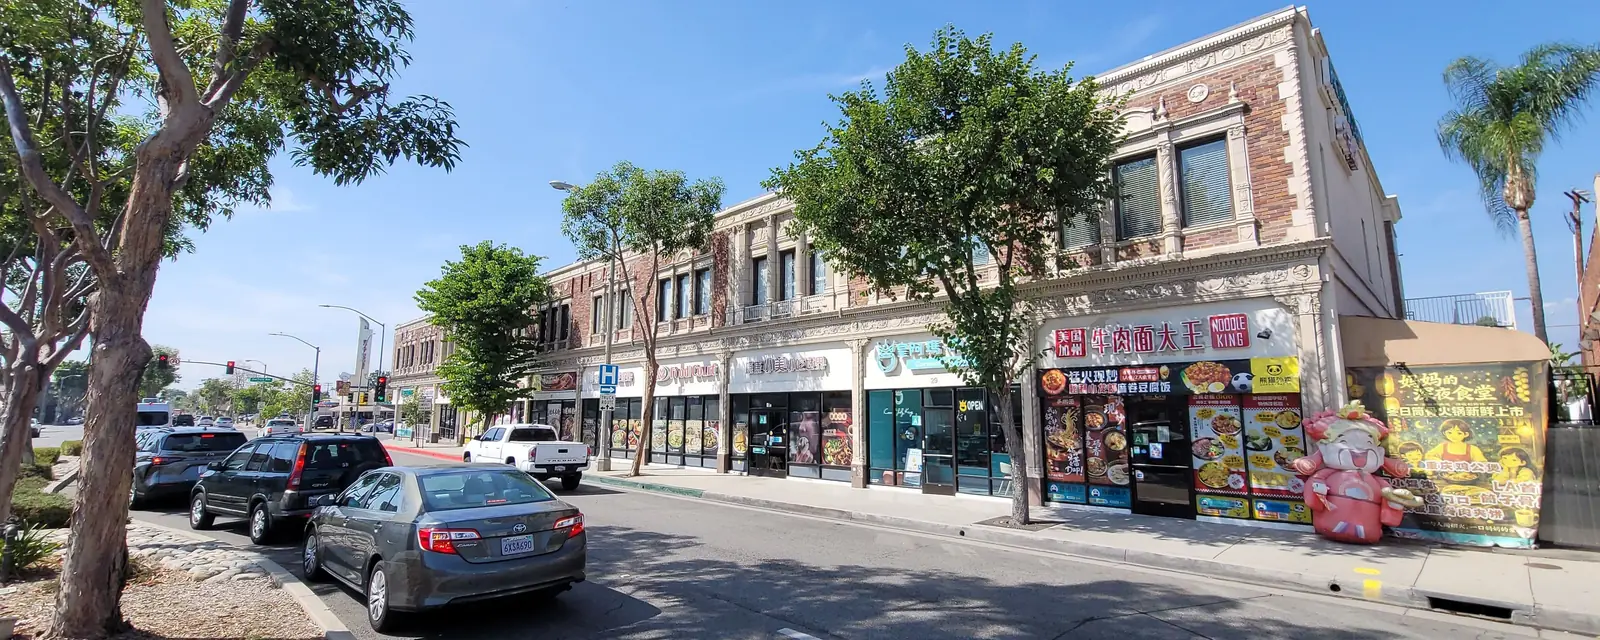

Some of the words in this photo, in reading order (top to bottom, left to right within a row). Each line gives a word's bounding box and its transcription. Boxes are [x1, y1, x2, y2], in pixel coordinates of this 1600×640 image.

[1211, 316, 1246, 332] NOODLE
[1058, 330, 1082, 343] 美国
[1091, 320, 1204, 355] 牛肉面大王
[1216, 332, 1244, 347] KING
[1059, 343, 1083, 356] 加州
[602, 366, 616, 384] H
[1398, 372, 1458, 389] 妈妈的
[1413, 384, 1497, 401] 深夜食堂
[967, 401, 984, 411] OPEN
[503, 540, 532, 553] 6XSA690
